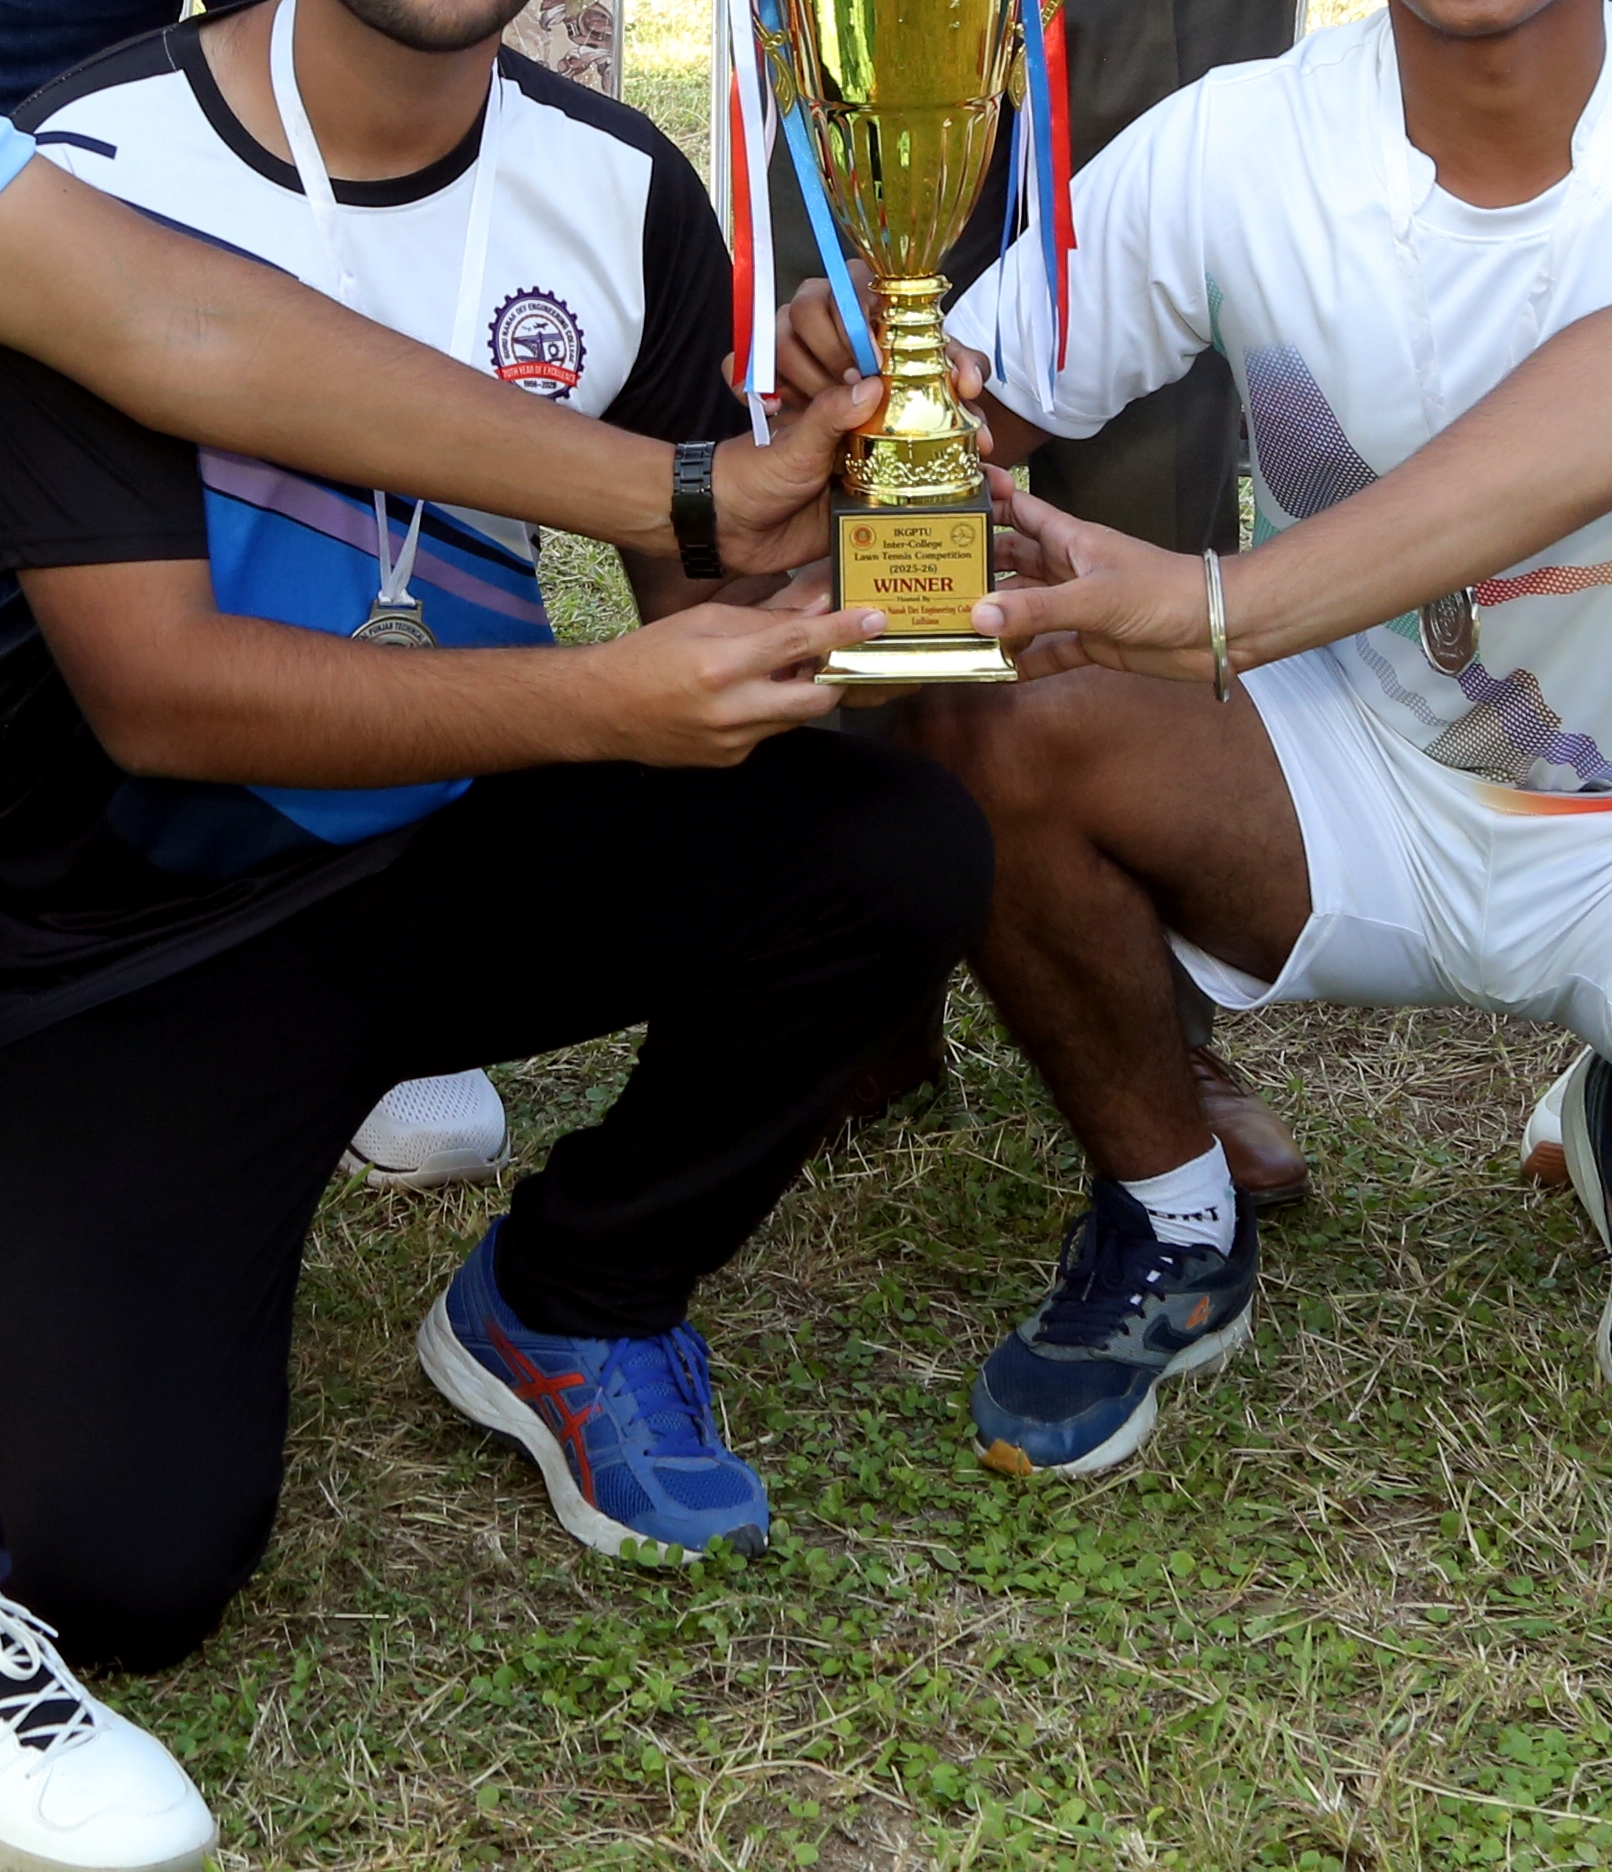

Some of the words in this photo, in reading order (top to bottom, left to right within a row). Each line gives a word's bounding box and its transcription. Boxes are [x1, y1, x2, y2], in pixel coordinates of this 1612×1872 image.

[528, 303, 568, 330] ENGINEERING
[894, 528, 931, 537] IKGPTU
[883, 540, 942, 549] Inter-College
[854, 553, 879, 561] Lawn
[882, 552, 912, 560] Tennis
[915, 551, 972, 560] Competition
[889, 564, 938, 574] (2025-26)
[873, 577, 954, 593] WINNER
[921, 606, 956, 615] Engineering
[912, 617, 939, 625] Ludhiana
[369, 622, 393, 635] PUNJAB
